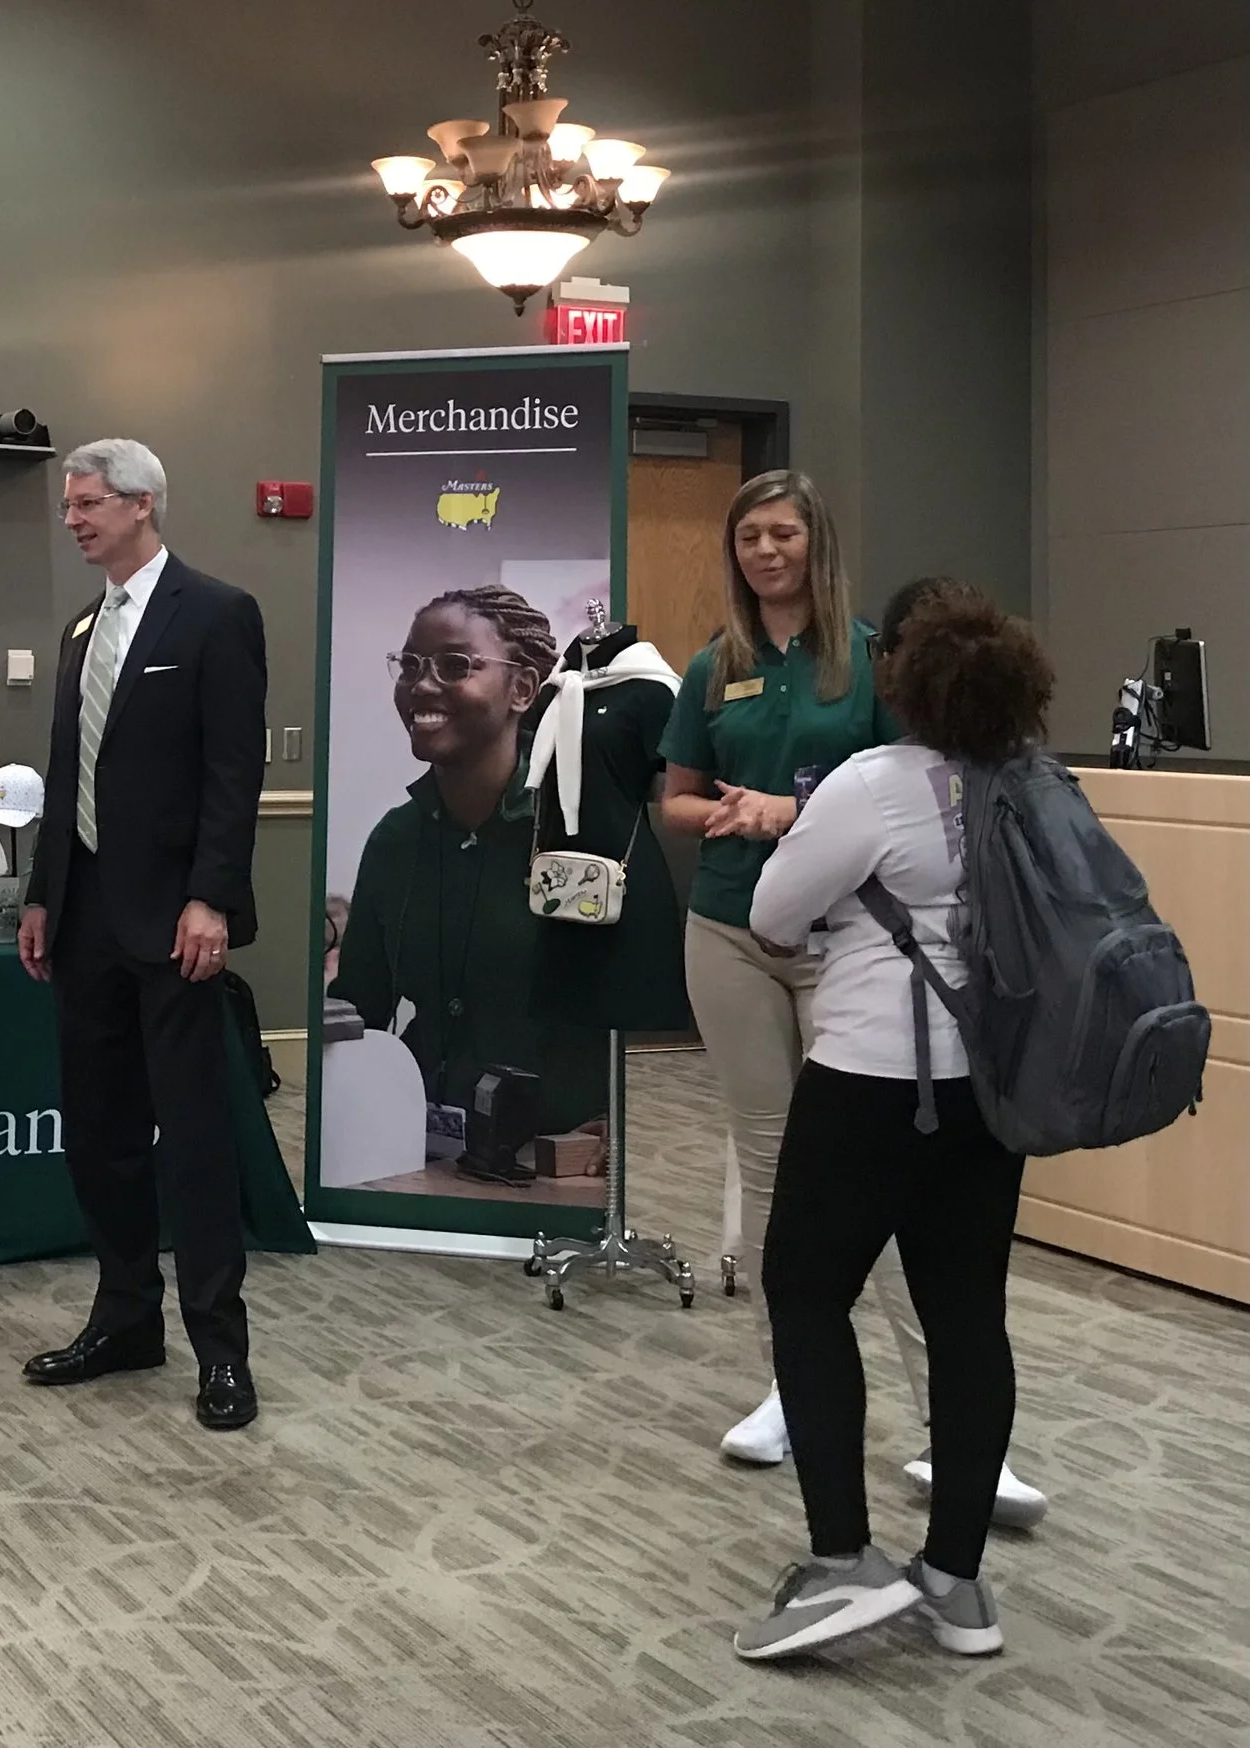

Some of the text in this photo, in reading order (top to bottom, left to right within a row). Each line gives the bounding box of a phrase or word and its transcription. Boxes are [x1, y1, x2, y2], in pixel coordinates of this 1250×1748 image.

[568, 310, 618, 344] EXIT
[365, 396, 579, 435] Merchandise
[441, 479, 493, 491] MASTERS
